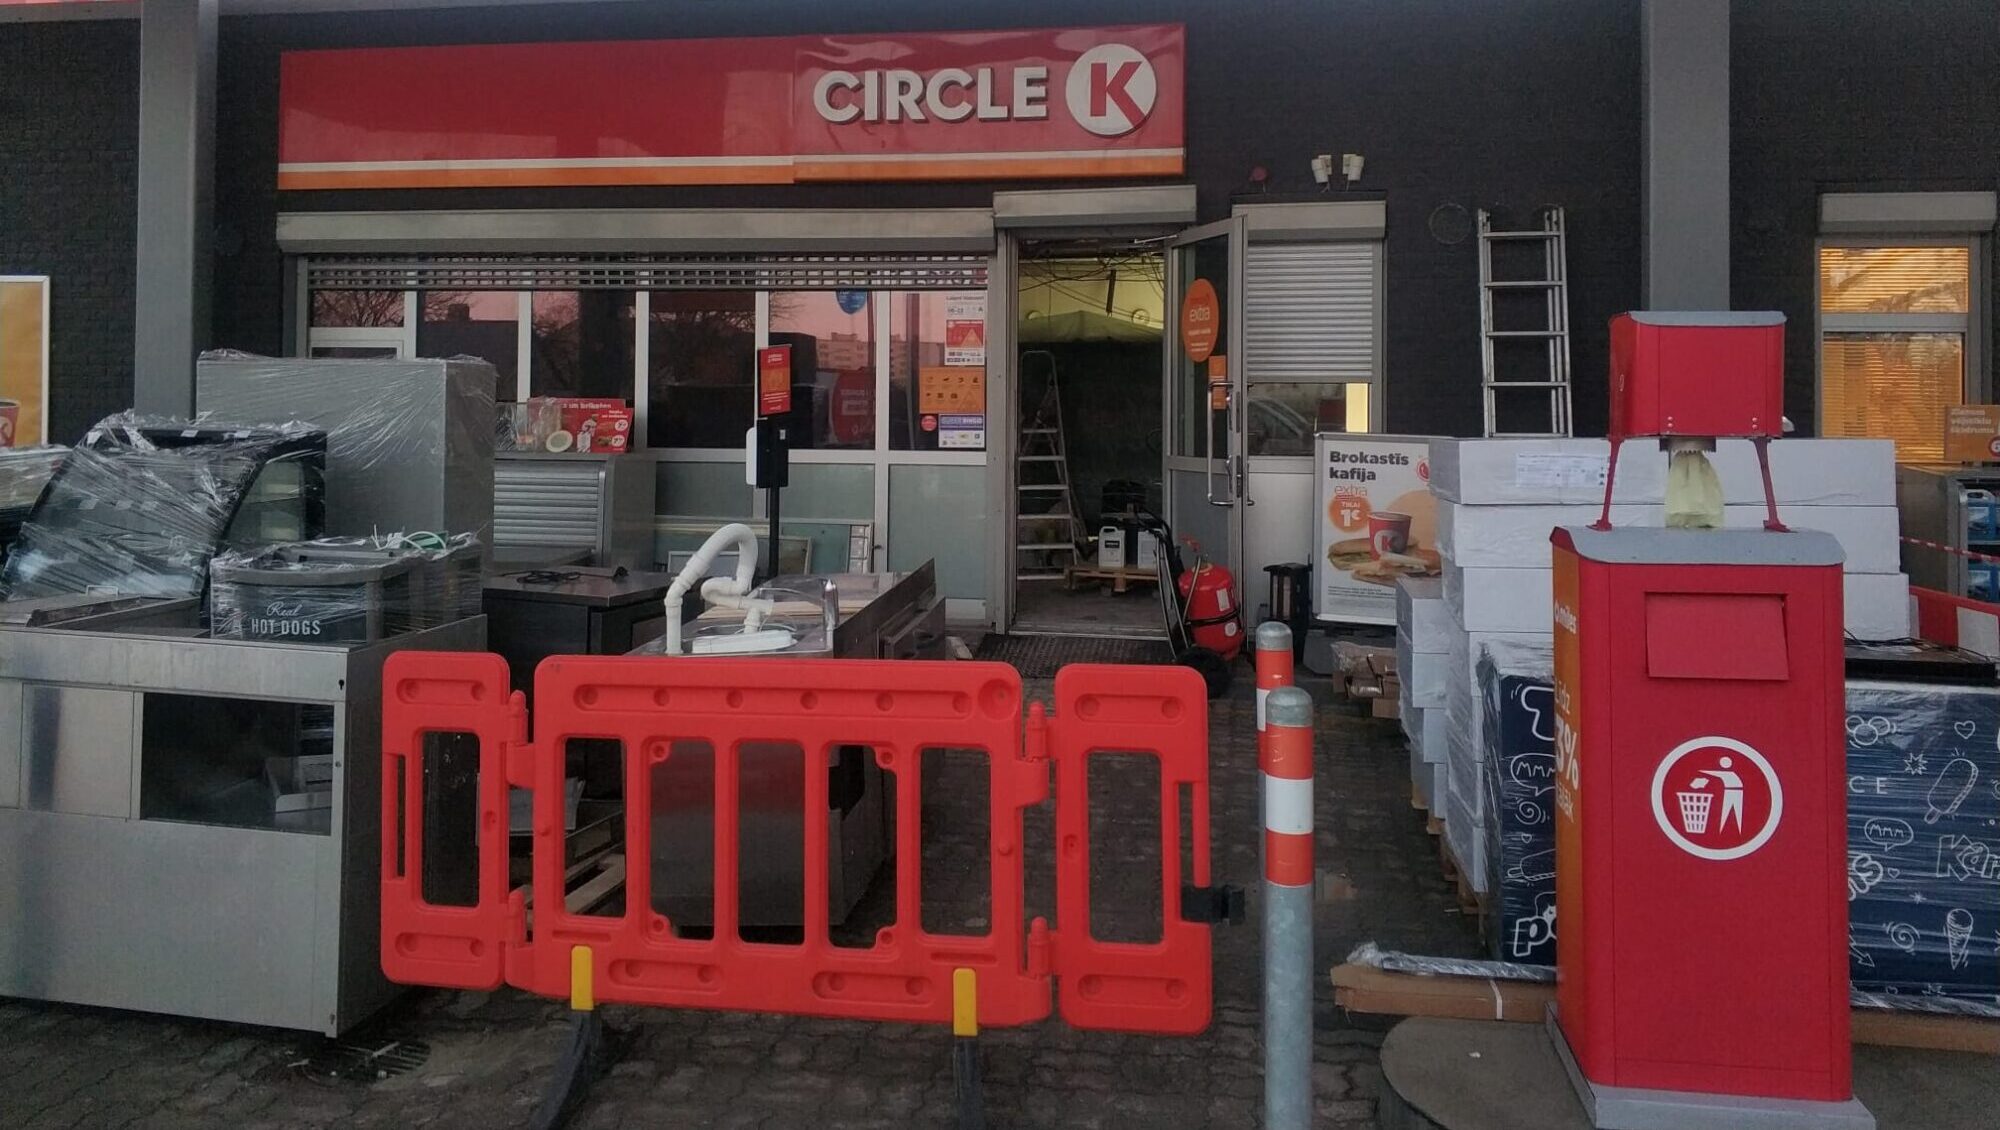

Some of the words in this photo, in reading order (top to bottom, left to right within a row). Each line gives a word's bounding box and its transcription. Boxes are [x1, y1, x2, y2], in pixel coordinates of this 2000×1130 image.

[813, 66, 1049, 124] CIRCLE
[1088, 59, 1148, 130] K
[1329, 450, 1409, 466] Brokastīs
[1329, 467, 1376, 483] kafija
[1334, 484, 1368, 497] extra
[266, 600, 303, 617] Real
[251, 618, 275, 634] HOT
[280, 619, 320, 635] DOGS
[1555, 713, 1579, 791] 3%
